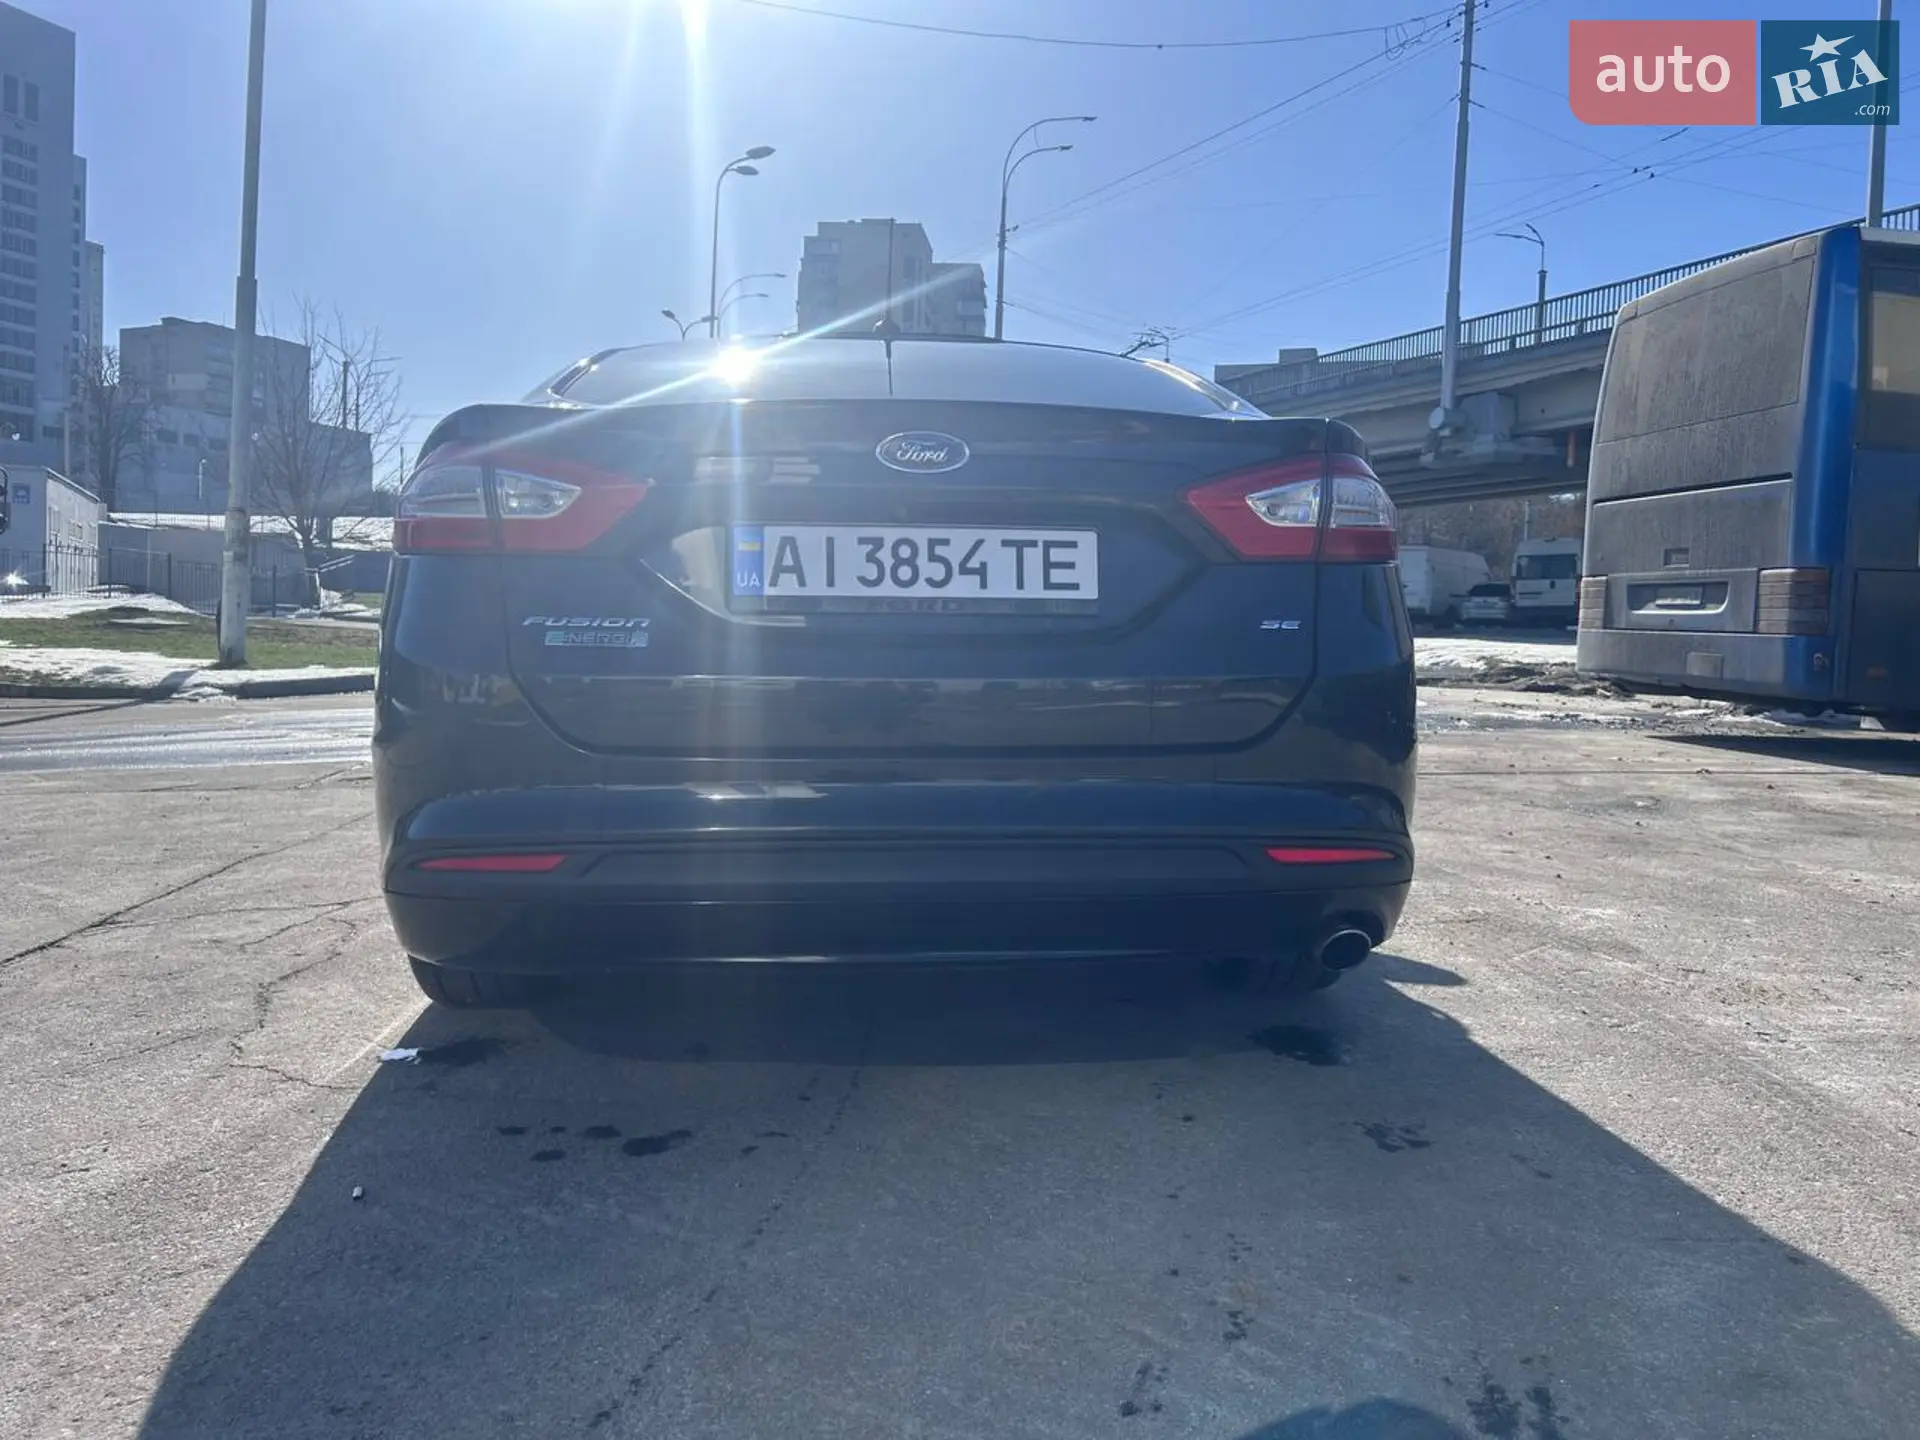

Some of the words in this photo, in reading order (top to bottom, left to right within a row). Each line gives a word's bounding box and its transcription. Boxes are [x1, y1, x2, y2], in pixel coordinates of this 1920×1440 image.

[897, 440, 949, 462] Ford
[856, 537, 988, 590] 3854
[1000, 539, 1081, 591] TE
[737, 573, 761, 588] UA
[1260, 620, 1301, 630] SE
